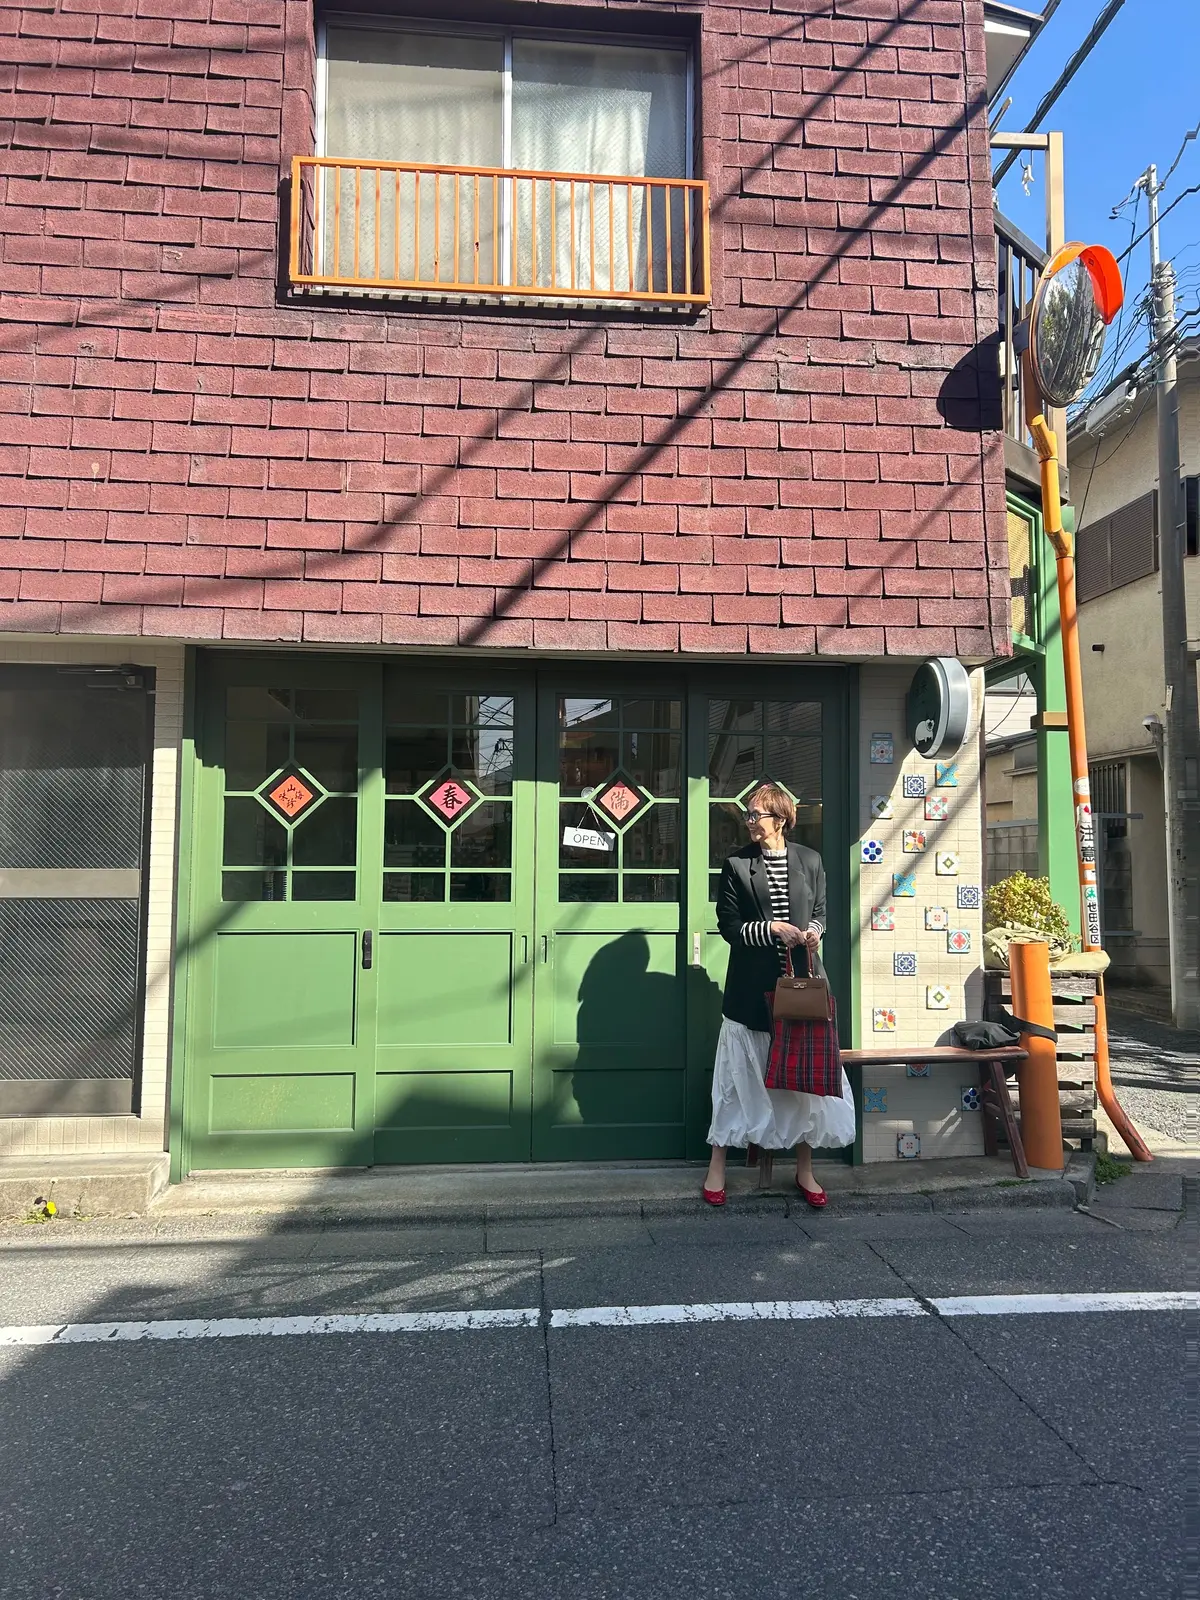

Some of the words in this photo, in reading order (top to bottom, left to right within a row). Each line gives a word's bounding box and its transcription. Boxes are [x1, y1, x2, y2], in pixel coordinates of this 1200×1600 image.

[440, 785, 463, 809] 春
[573, 834, 605, 846] OPEN
[1080, 824, 1096, 862] 注意
[1087, 902, 1100, 944] 世田谷区
